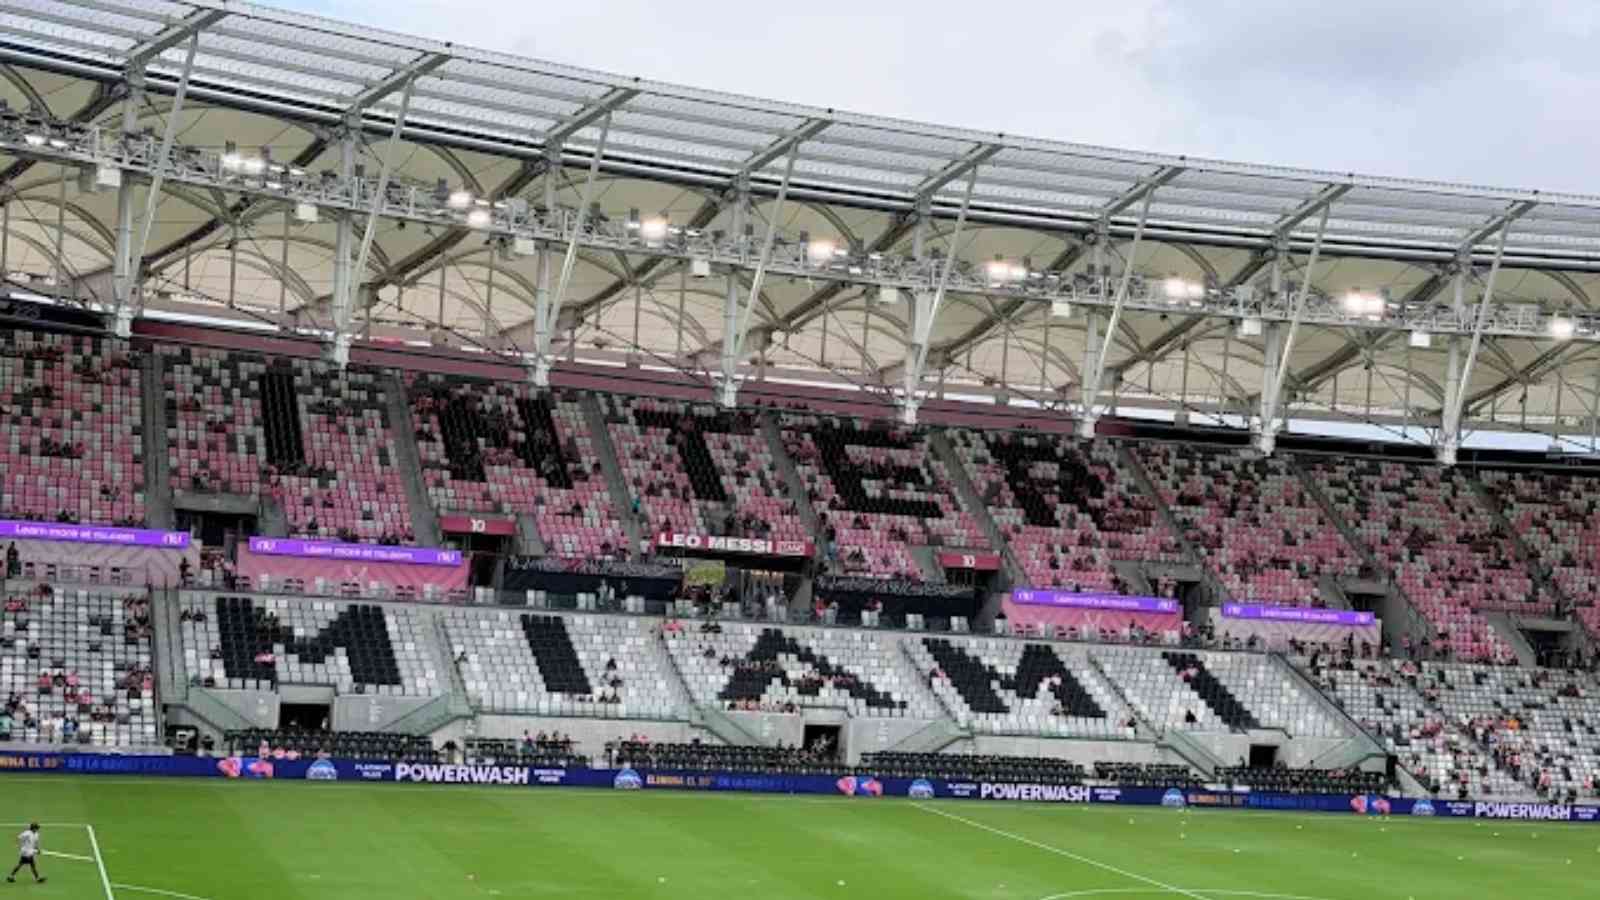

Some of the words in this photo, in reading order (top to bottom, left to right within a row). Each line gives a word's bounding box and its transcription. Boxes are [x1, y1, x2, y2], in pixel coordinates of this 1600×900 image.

[258, 364, 1106, 528] INTER
[471, 518, 486, 532] 10
[660, 533, 701, 549] LEO
[707, 536, 773, 554] MESSI
[215, 597, 1261, 733] MIAMI
[395, 763, 528, 784] POWERWASH
[980, 783, 1090, 802] POWERWASH
[1475, 802, 1570, 820] POWERWASH
